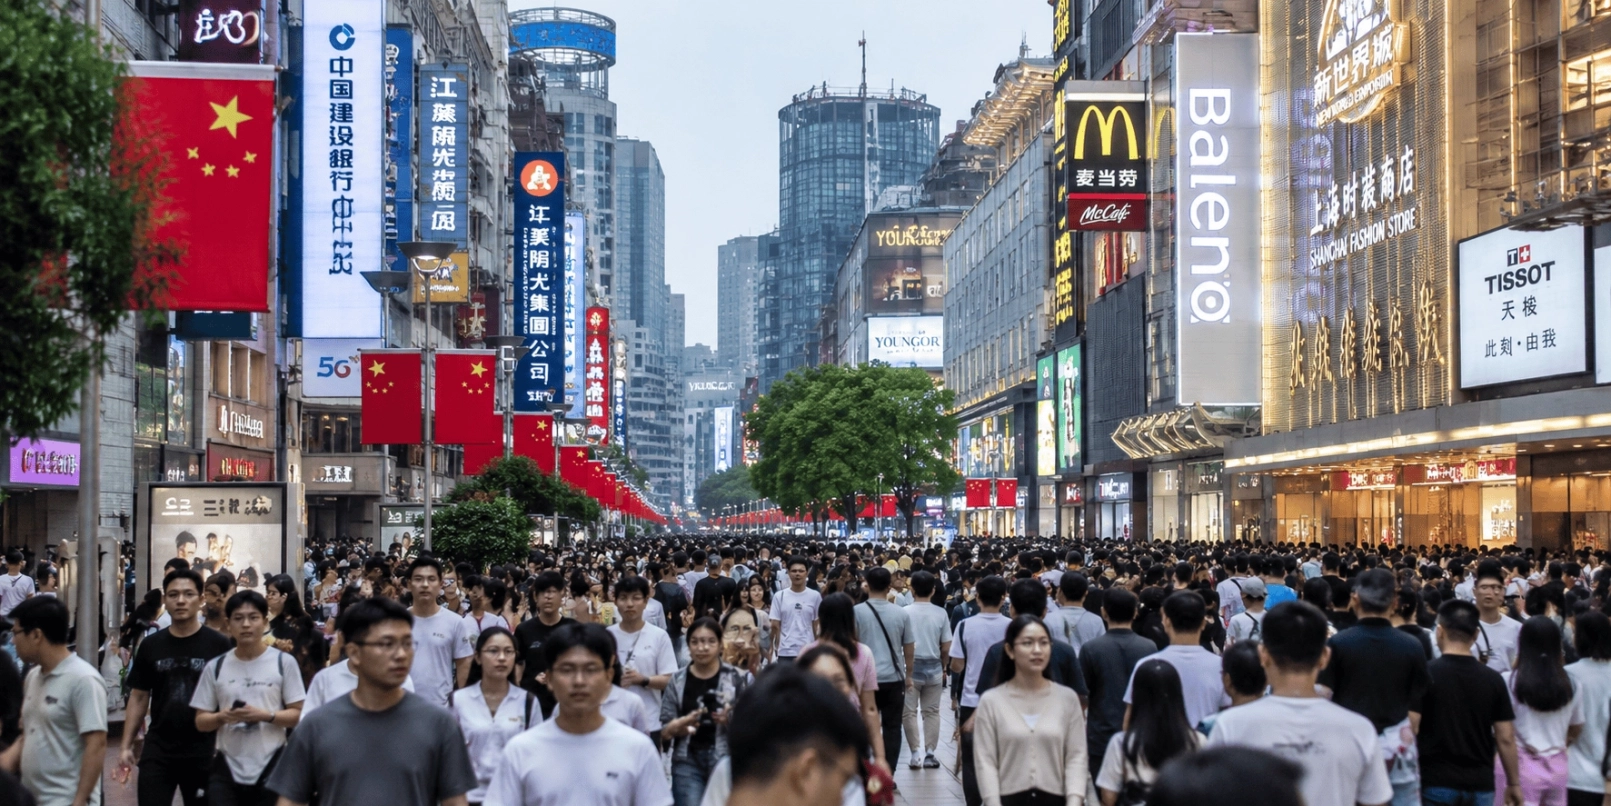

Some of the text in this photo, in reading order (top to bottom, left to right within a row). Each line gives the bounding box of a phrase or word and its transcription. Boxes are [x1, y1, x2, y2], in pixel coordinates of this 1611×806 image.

[1350, 220, 1385, 253] FASHION
[1388, 208, 1416, 237] STORE
[1485, 261, 1555, 294] TISSOT
[875, 336, 940, 348] YOUNGOR
